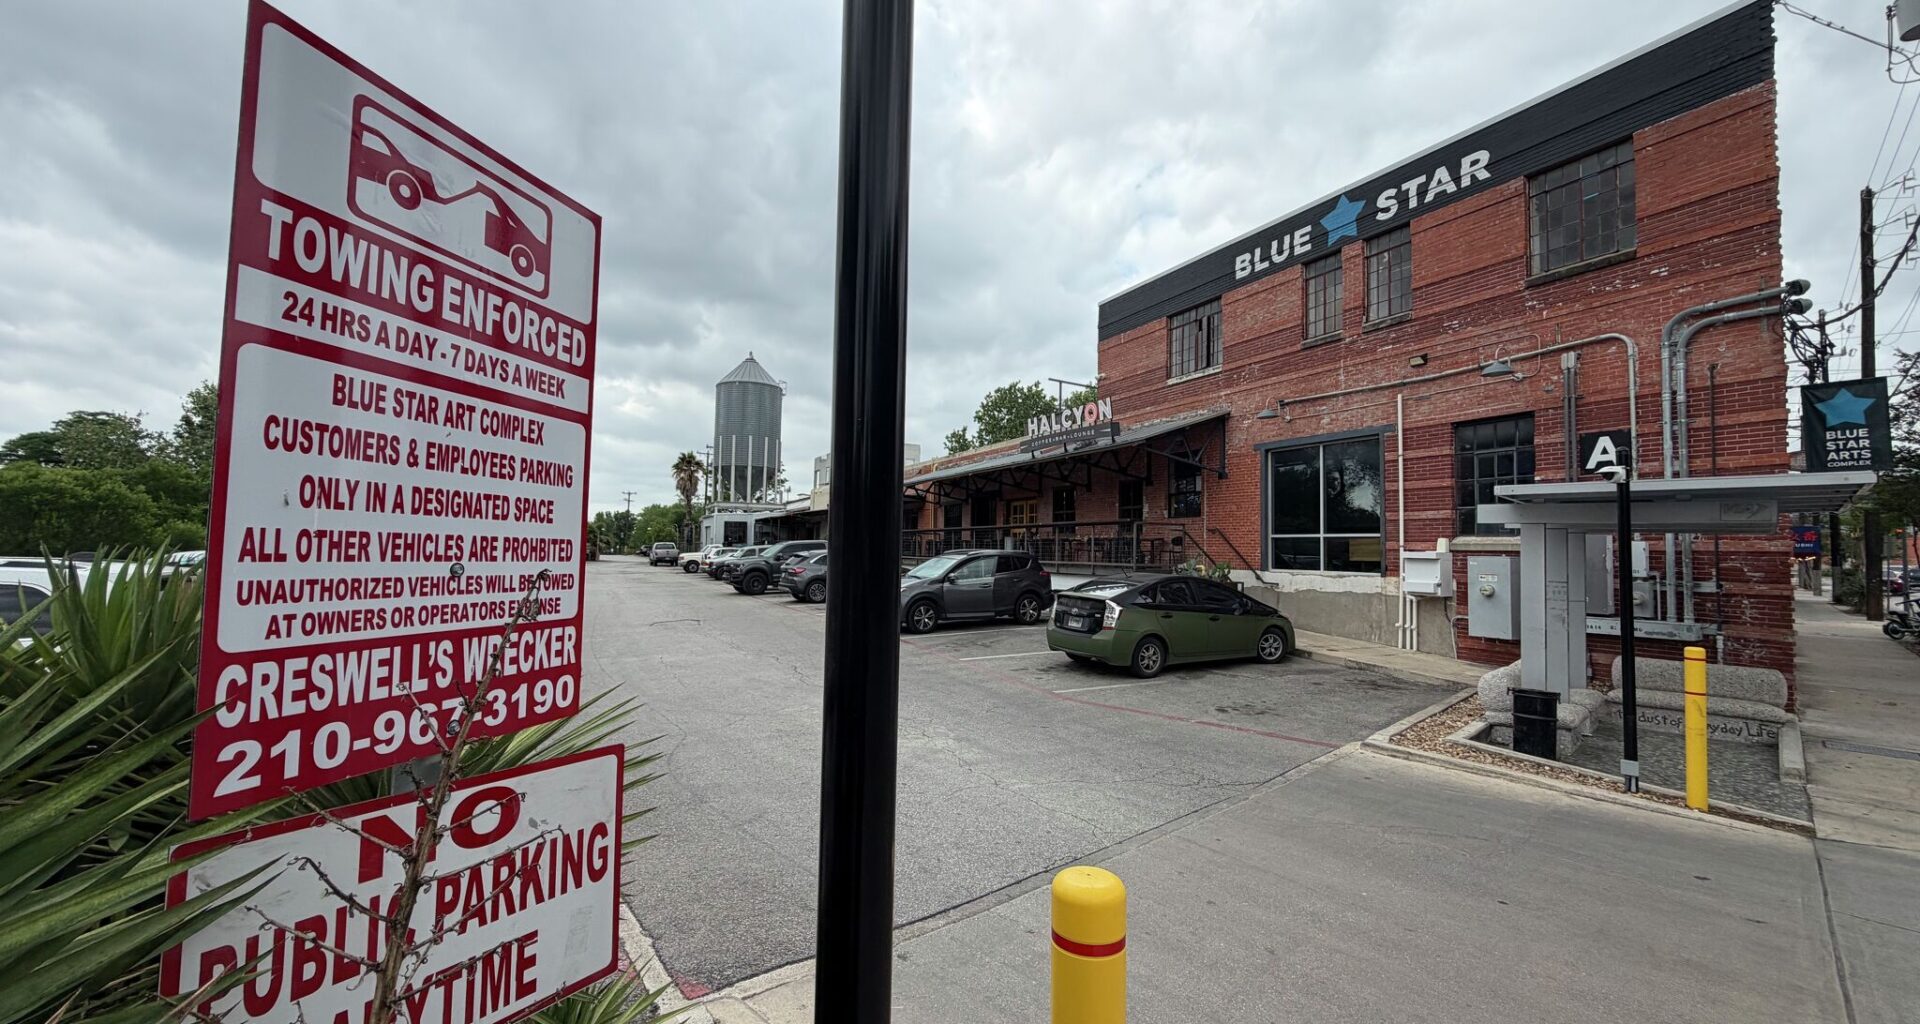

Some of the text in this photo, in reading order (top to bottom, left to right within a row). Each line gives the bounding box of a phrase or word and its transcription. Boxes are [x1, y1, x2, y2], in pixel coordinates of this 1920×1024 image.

[1234, 149, 1492, 280] BLUE STAR
[260, 199, 586, 368] TOWING ENFORCED
[281, 290, 315, 328] 24
[320, 302, 371, 343] HRS
[374, 321, 391, 350] A
[394, 326, 439, 361] DAY
[450, 343, 461, 368] 7
[464, 348, 509, 382] DAYS
[511, 361, 522, 387] A
[525, 368, 565, 400] WEEK
[332, 373, 545, 446] BLUE STAR ART COMPLEX
[1027, 397, 1112, 437] HALCYON
[1826, 428, 1869, 439] BLUE
[263, 414, 574, 489] CUSTOMERS & EMPLOYEES PARKING
[1585, 435, 1619, 470] A
[1826, 439, 1870, 450] STAR
[1827, 449, 1872, 461] ARTS
[1827, 460, 1872, 468] COMPLEX
[299, 474, 554, 524] ONLY IN A DESIGNATED SPACE
[238, 526, 287, 563] ALL
[295, 528, 370, 563] OTHER
[378, 531, 464, 563] VEHICLES
[468, 535, 498, 562] ARE
[236, 576, 404, 606] UNAUTHORIZED
[408, 574, 483, 597] VEHICLES
[486, 575, 516, 594] WILL
[519, 574, 535, 592] BE
[265, 597, 561, 640] AT OWNERS OR OPERATORS EPNSE
[214, 626, 576, 728] CRESWELL'S WRECKER
[212, 674, 575, 798] 210-967-3190
[1669, 717, 1683, 731] of
[358, 786, 521, 884] NO
[197, 821, 609, 1020] PUBLIC PARKING
[332, 929, 538, 1024] YTIME
